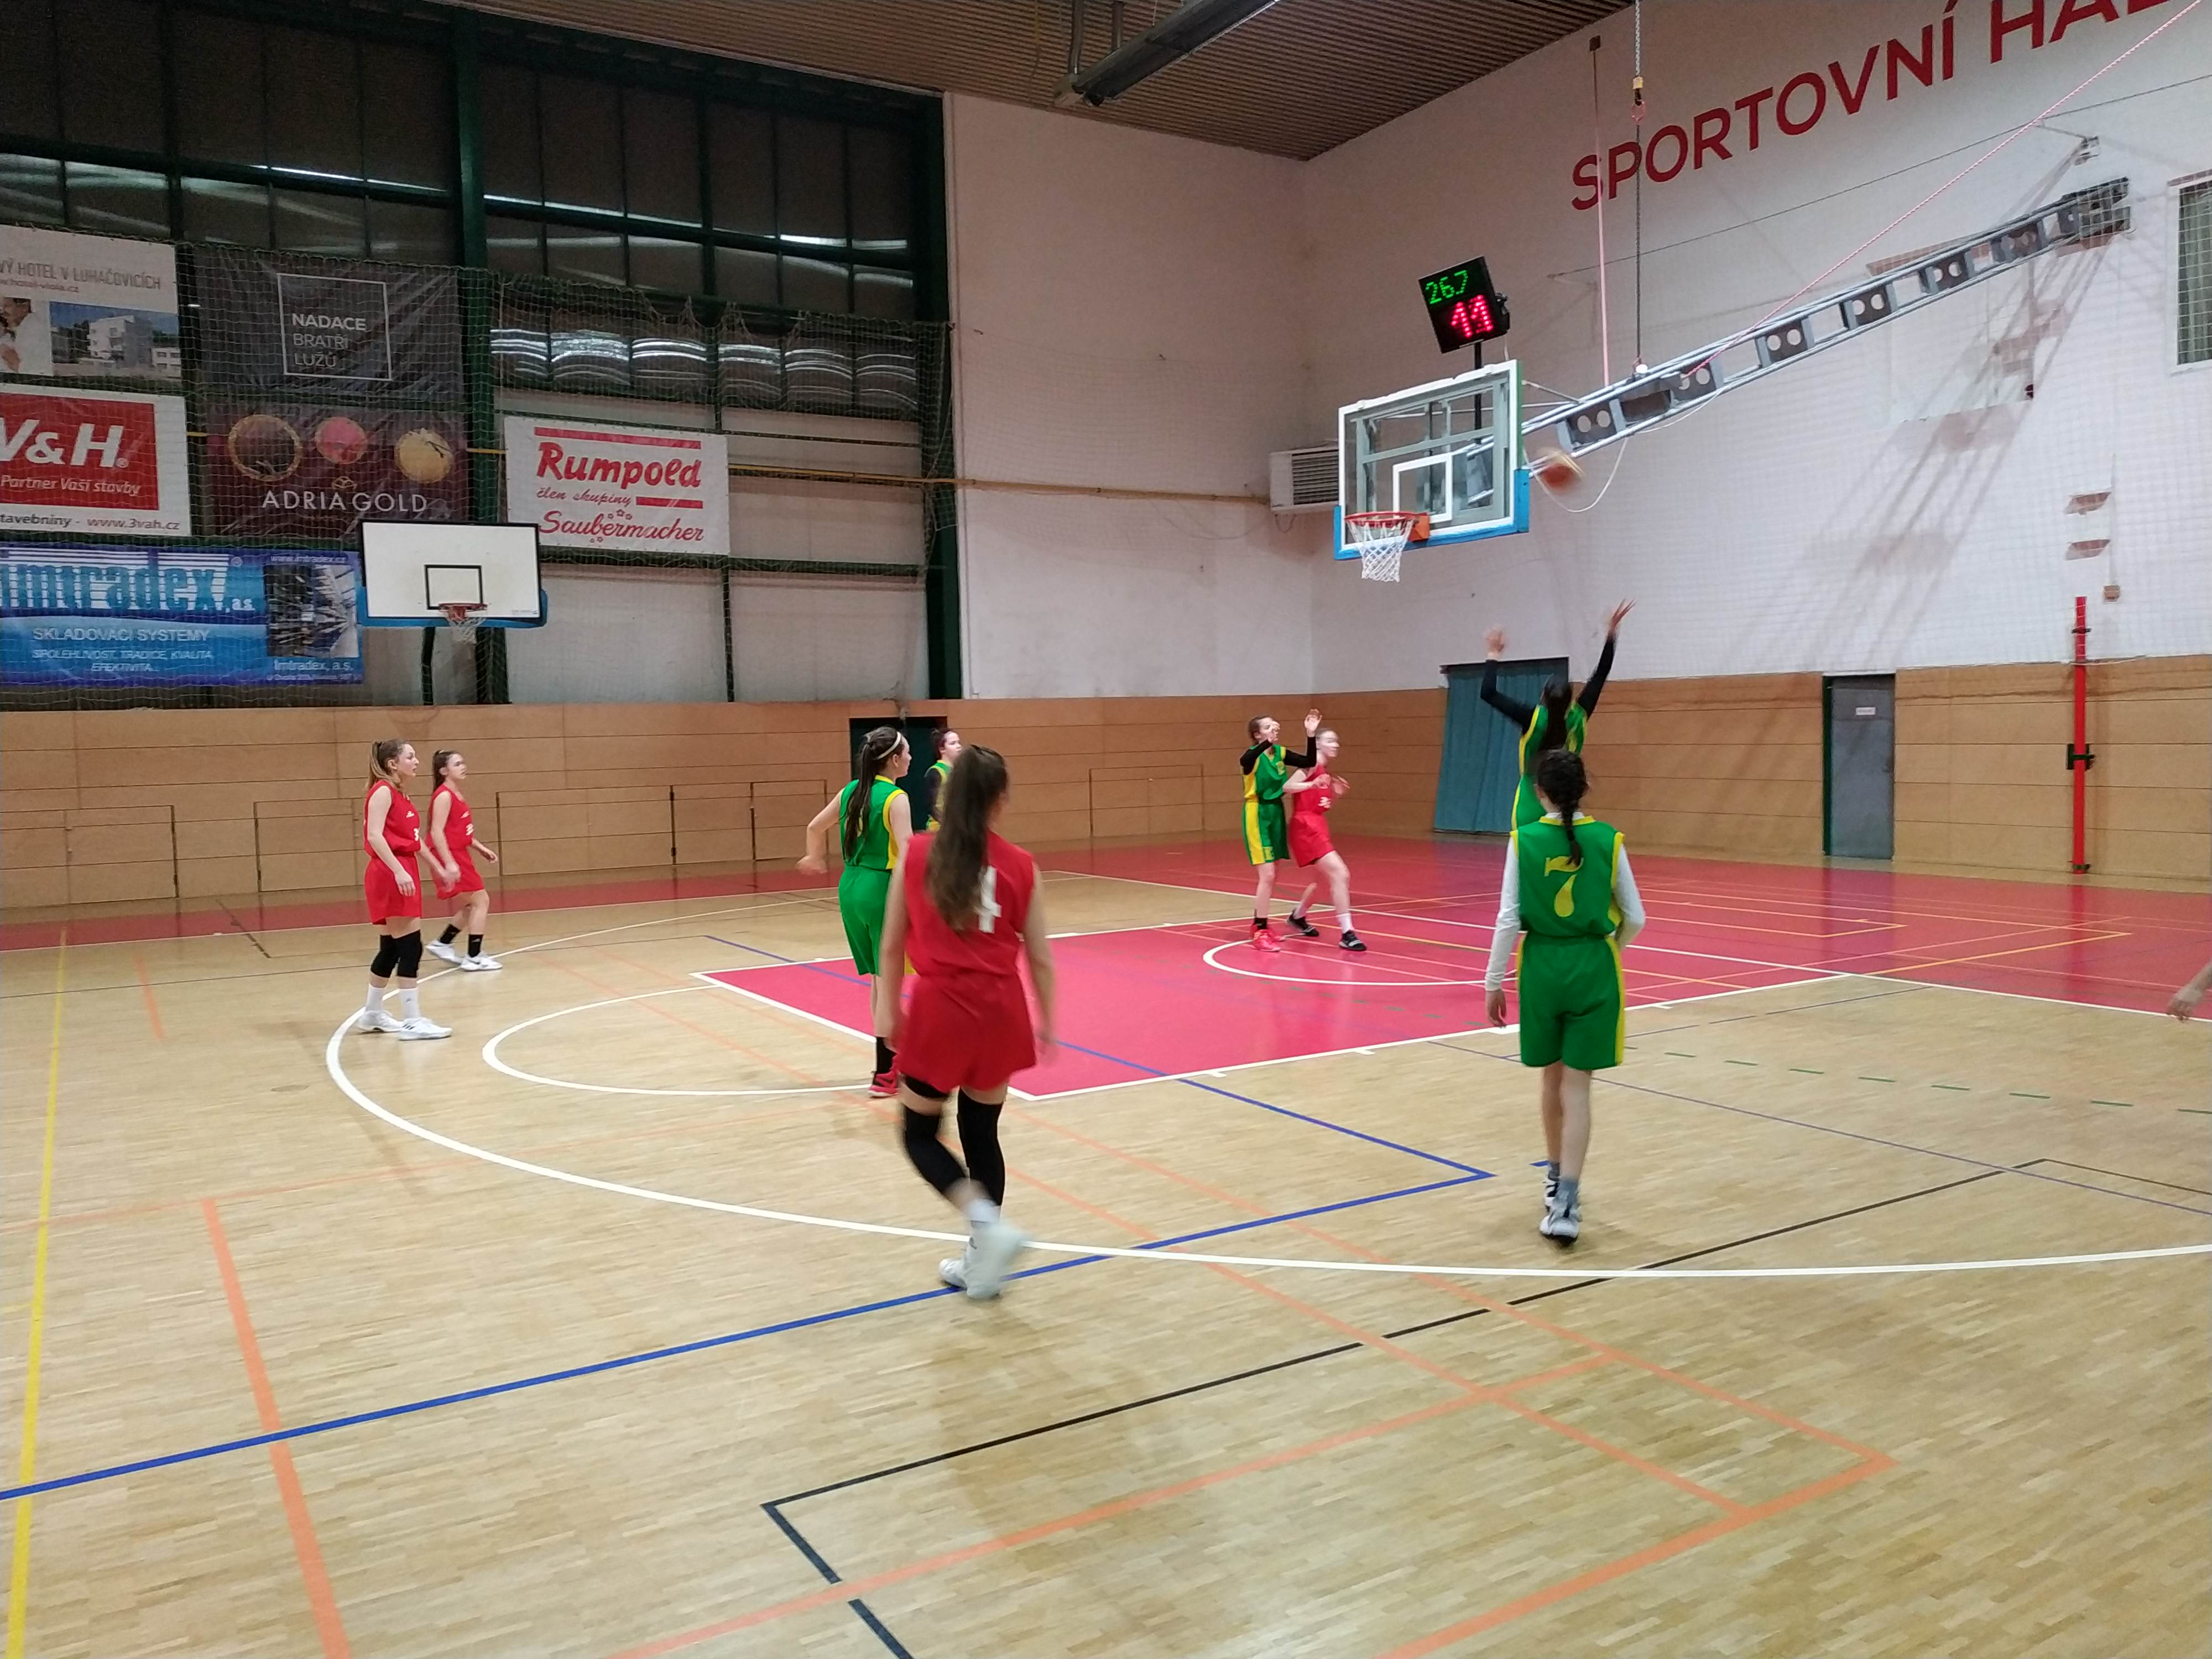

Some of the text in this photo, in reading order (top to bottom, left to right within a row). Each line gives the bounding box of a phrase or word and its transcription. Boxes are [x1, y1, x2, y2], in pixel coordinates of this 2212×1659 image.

[1571, 0, 2171, 211] SPORTOVNÍ HA
[18, 262, 57, 279] HOTEL
[60, 267, 69, 280] V
[291, 313, 366, 331] NADACE
[536, 442, 702, 489] Rumpold
[1, 474, 57, 489] Partner
[92, 480, 142, 497] stavby
[536, 486, 632, 507] člen skupiny
[87, 518, 180, 530] www.3vah.cz
[539, 510, 704, 541] Saubermacher
[1545, 855, 1584, 918] 7
